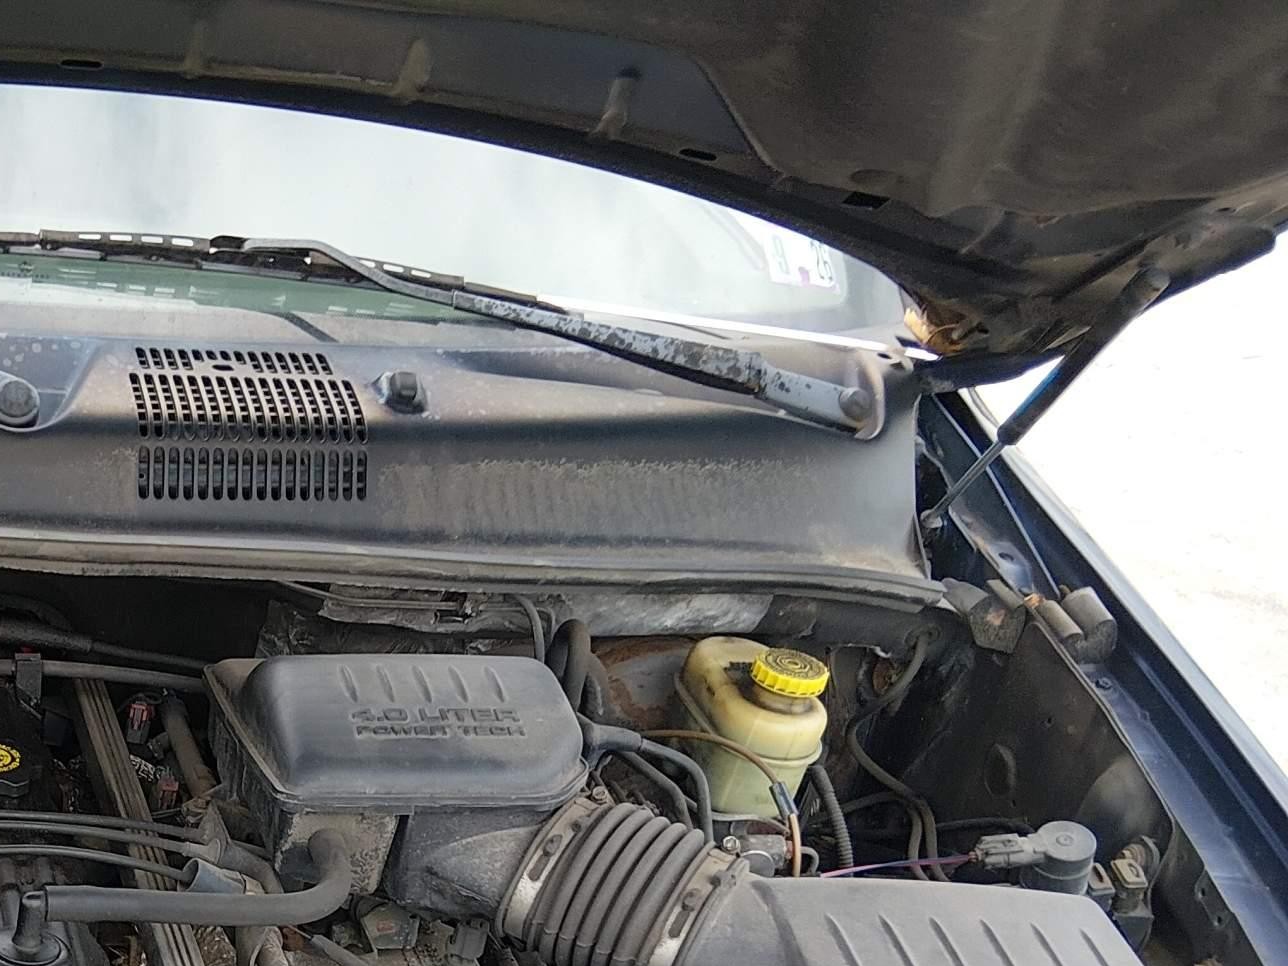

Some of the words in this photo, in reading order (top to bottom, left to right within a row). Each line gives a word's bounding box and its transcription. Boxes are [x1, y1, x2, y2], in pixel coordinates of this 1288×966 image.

[351, 708, 408, 721] 4.0
[418, 708, 520, 721] LITER
[356, 725, 449, 738] POWER
[458, 725, 527, 738] TECH
